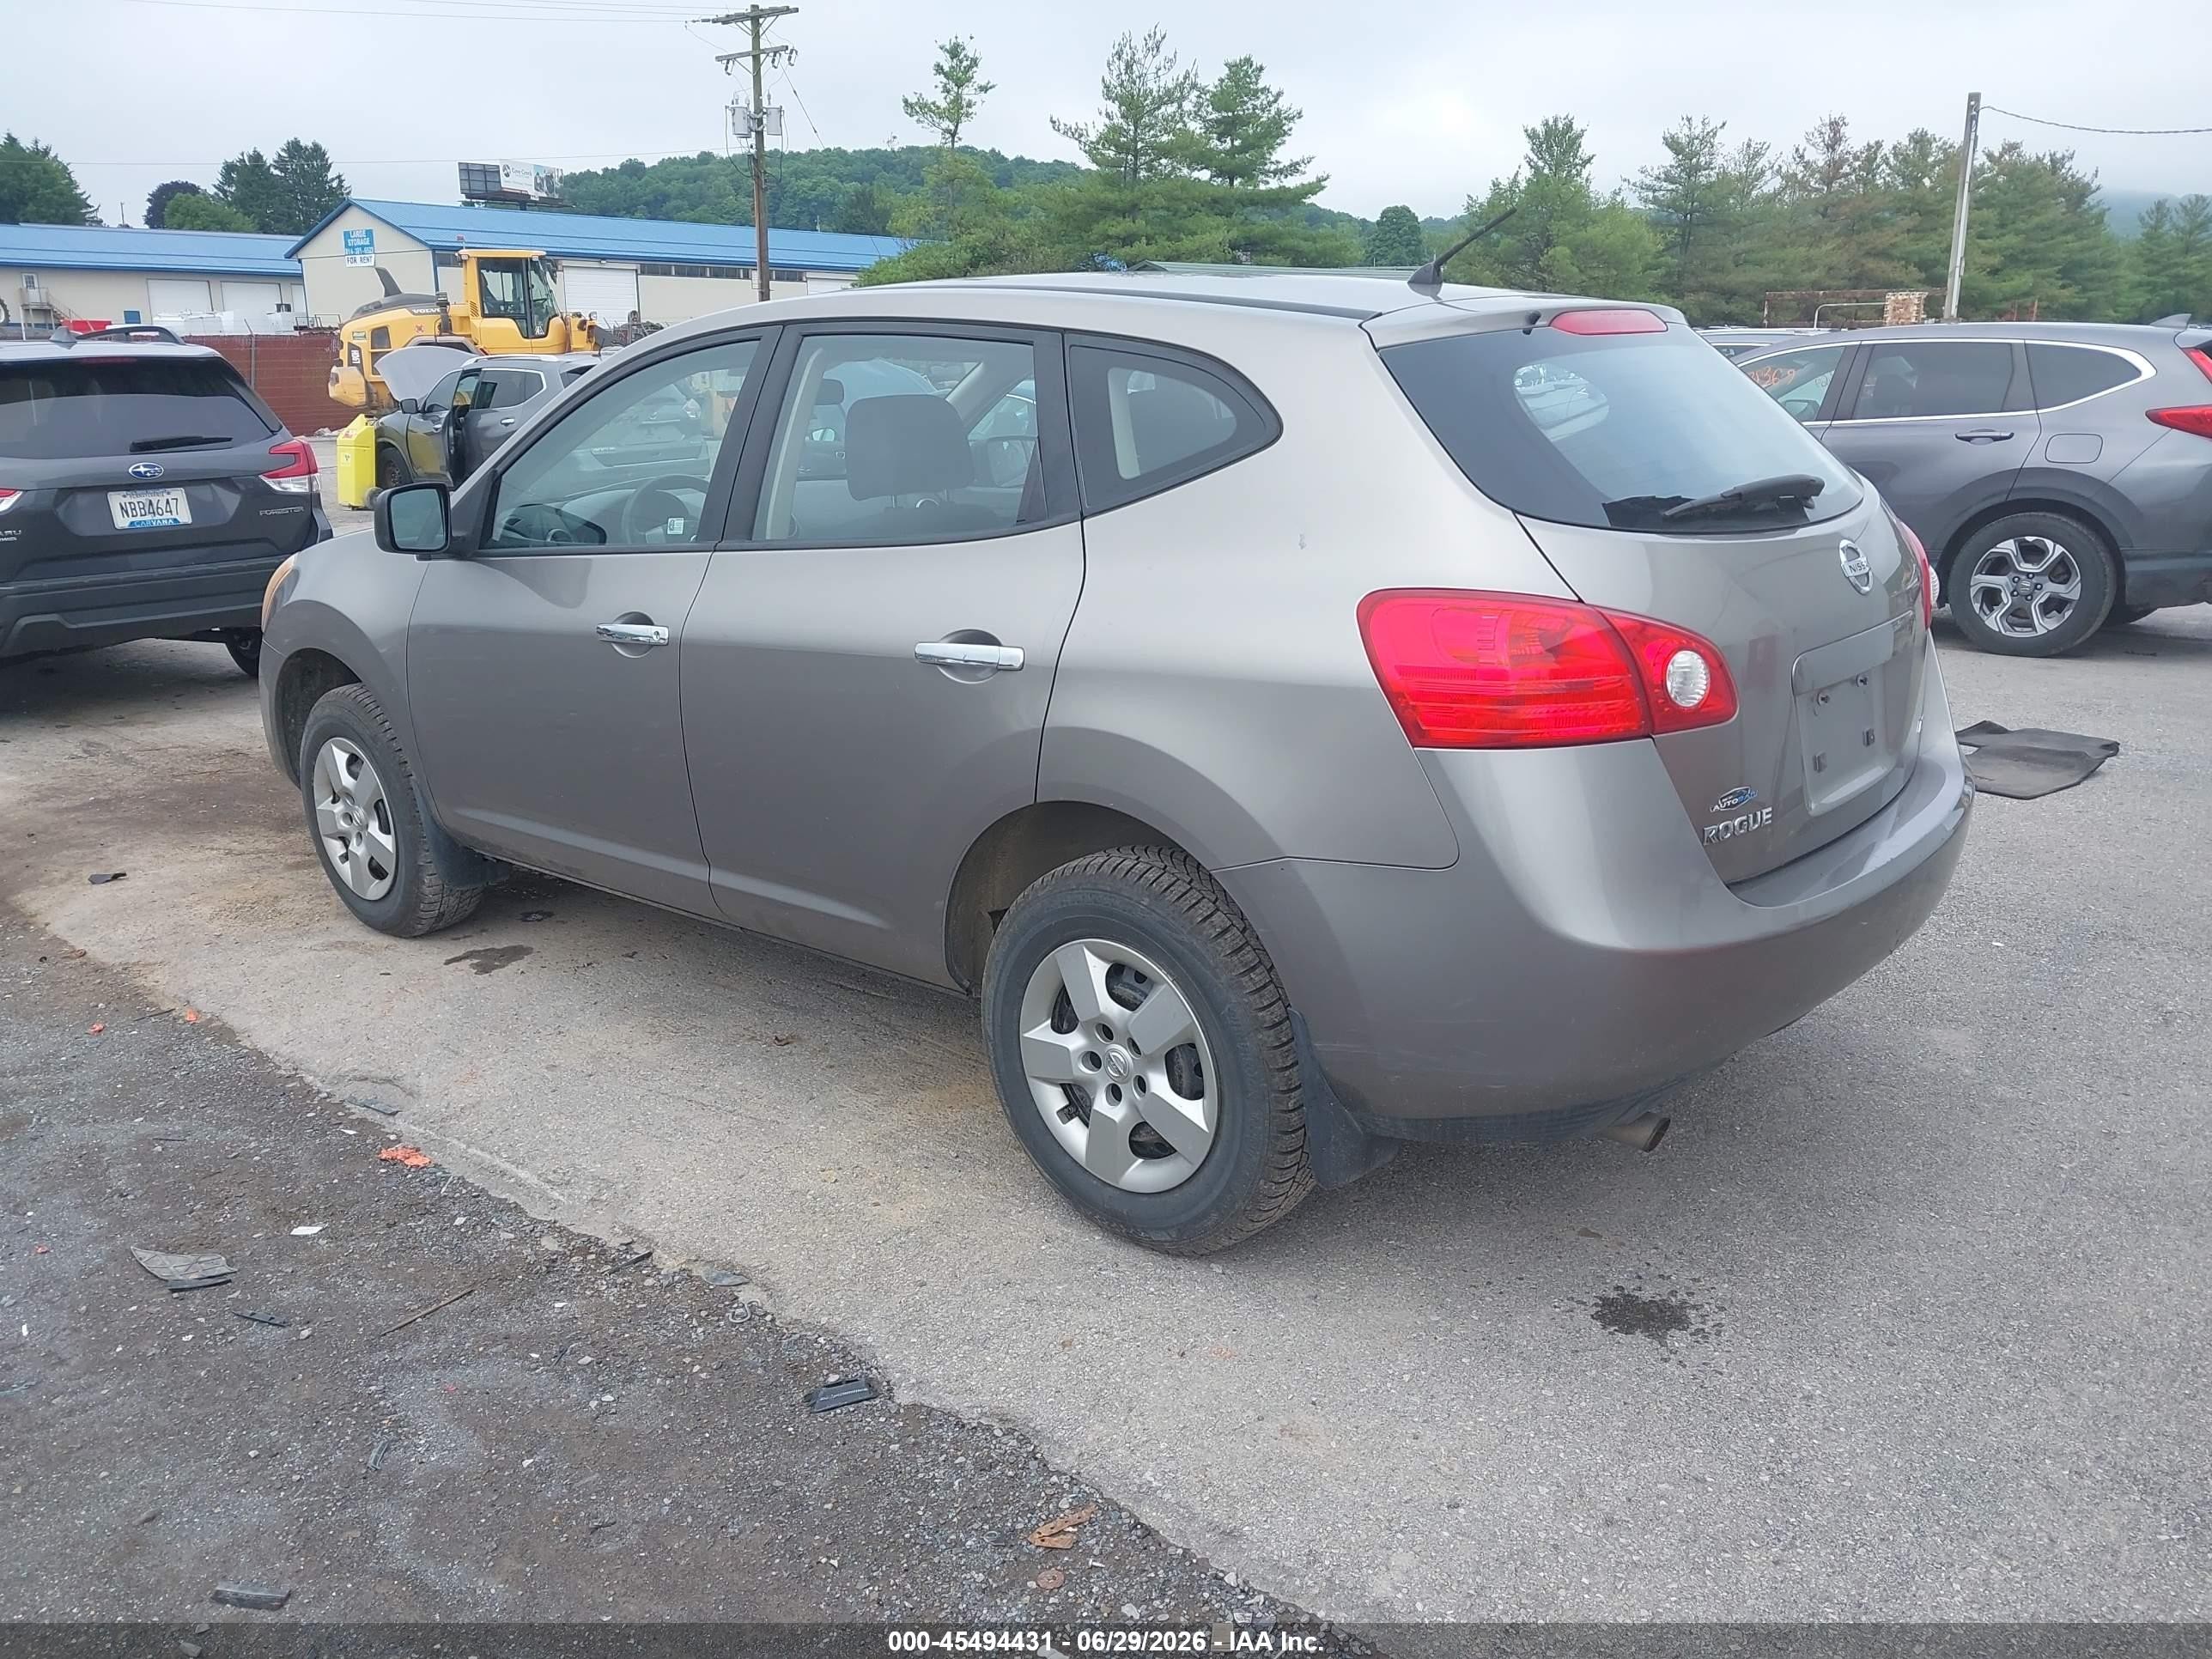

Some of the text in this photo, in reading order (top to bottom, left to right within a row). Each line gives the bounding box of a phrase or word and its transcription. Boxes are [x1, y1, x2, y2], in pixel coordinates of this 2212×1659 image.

[350, 229, 366, 238] LARGE
[347, 238, 371, 246] STORAGE
[359, 255, 373, 264] RENT
[118, 497, 179, 519] NBB4647
[134, 519, 174, 527] CARVANA
[1703, 807, 1772, 846] ROGUE
